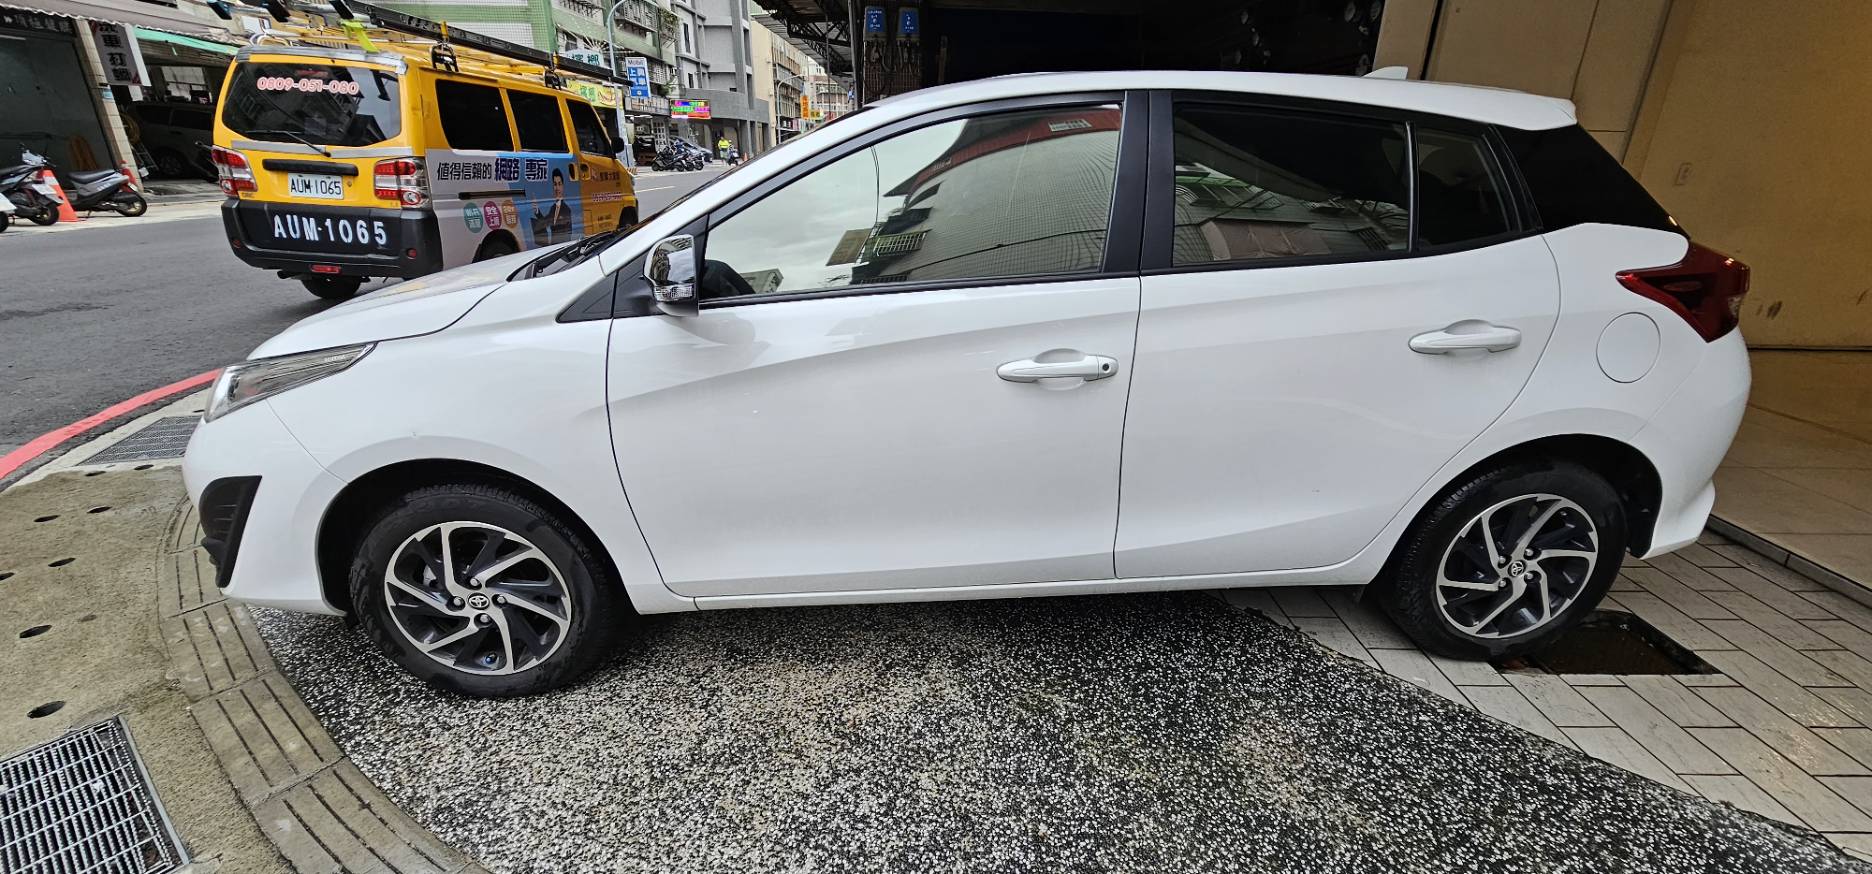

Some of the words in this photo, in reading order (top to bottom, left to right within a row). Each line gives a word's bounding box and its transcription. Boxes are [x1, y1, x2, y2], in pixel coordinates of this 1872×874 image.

[256, 76, 360, 95] 0809-051-080
[289, 177, 342, 197] AUM-1065
[273, 213, 387, 246] AUM-1065
